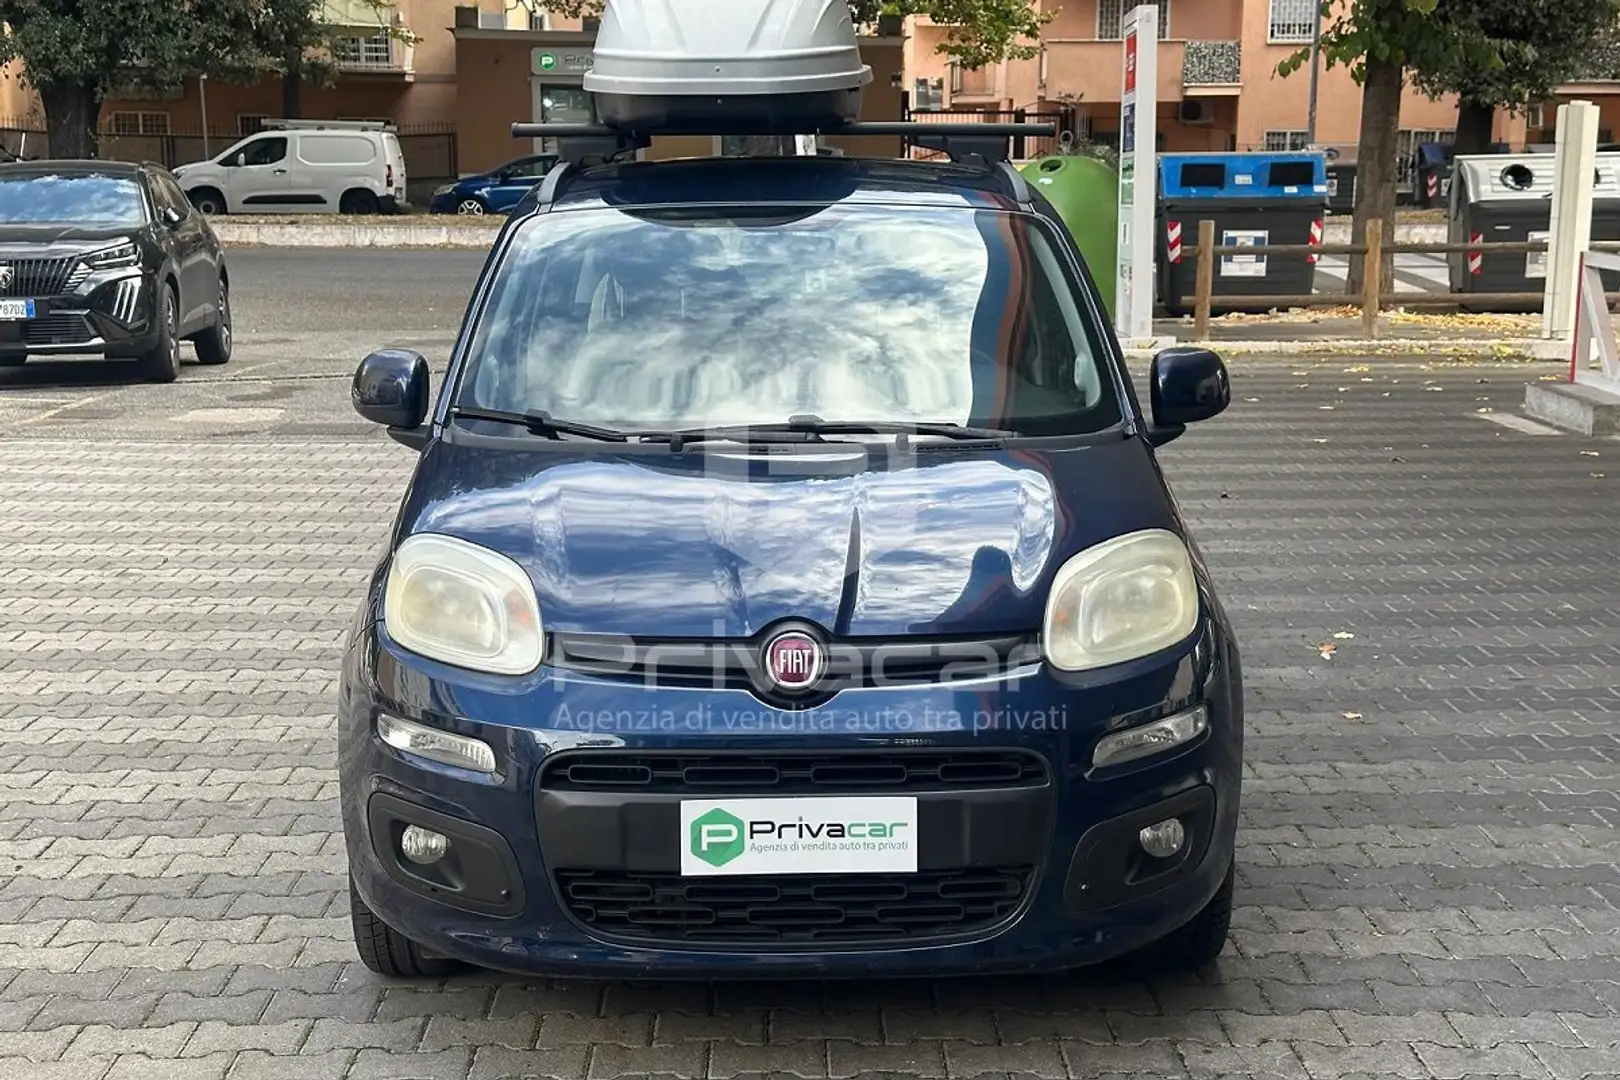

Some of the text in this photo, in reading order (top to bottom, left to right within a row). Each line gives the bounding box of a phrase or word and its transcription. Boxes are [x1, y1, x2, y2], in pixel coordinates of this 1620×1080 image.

[779, 649, 812, 674] FIAT
[749, 816, 909, 840] Privacar
[750, 840, 909, 855] Agenzia di vendita auto tra privati
